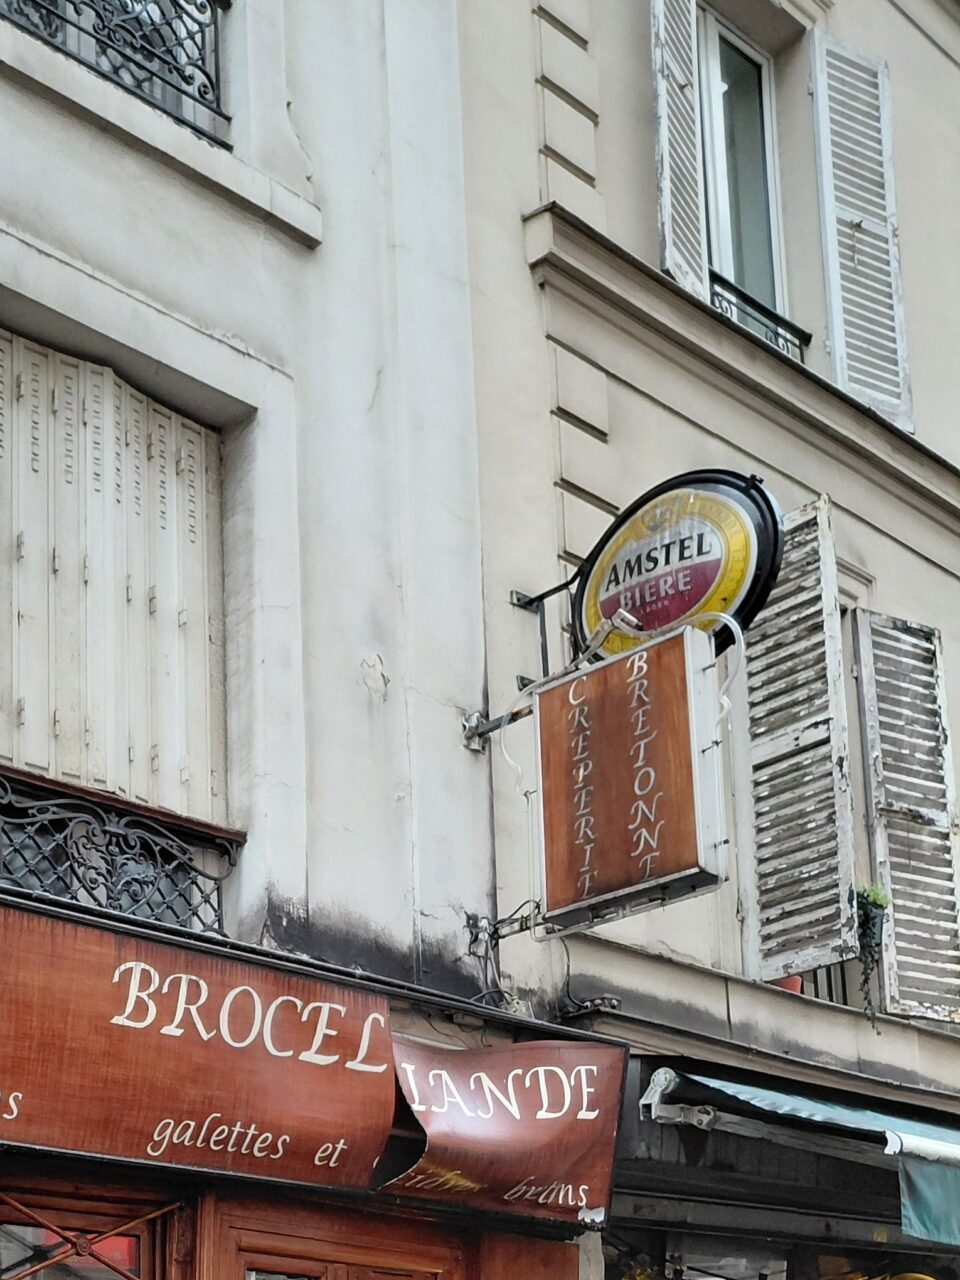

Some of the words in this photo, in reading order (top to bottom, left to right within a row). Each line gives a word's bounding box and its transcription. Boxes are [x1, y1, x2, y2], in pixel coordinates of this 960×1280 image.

[605, 532, 713, 592] AMSTEL
[567, 675, 598, 899] CREPERIE
[625, 650, 664, 882] BRETONNE
[146, 1112, 291, 1158] galettes
[314, 1138, 349, 1170] et
